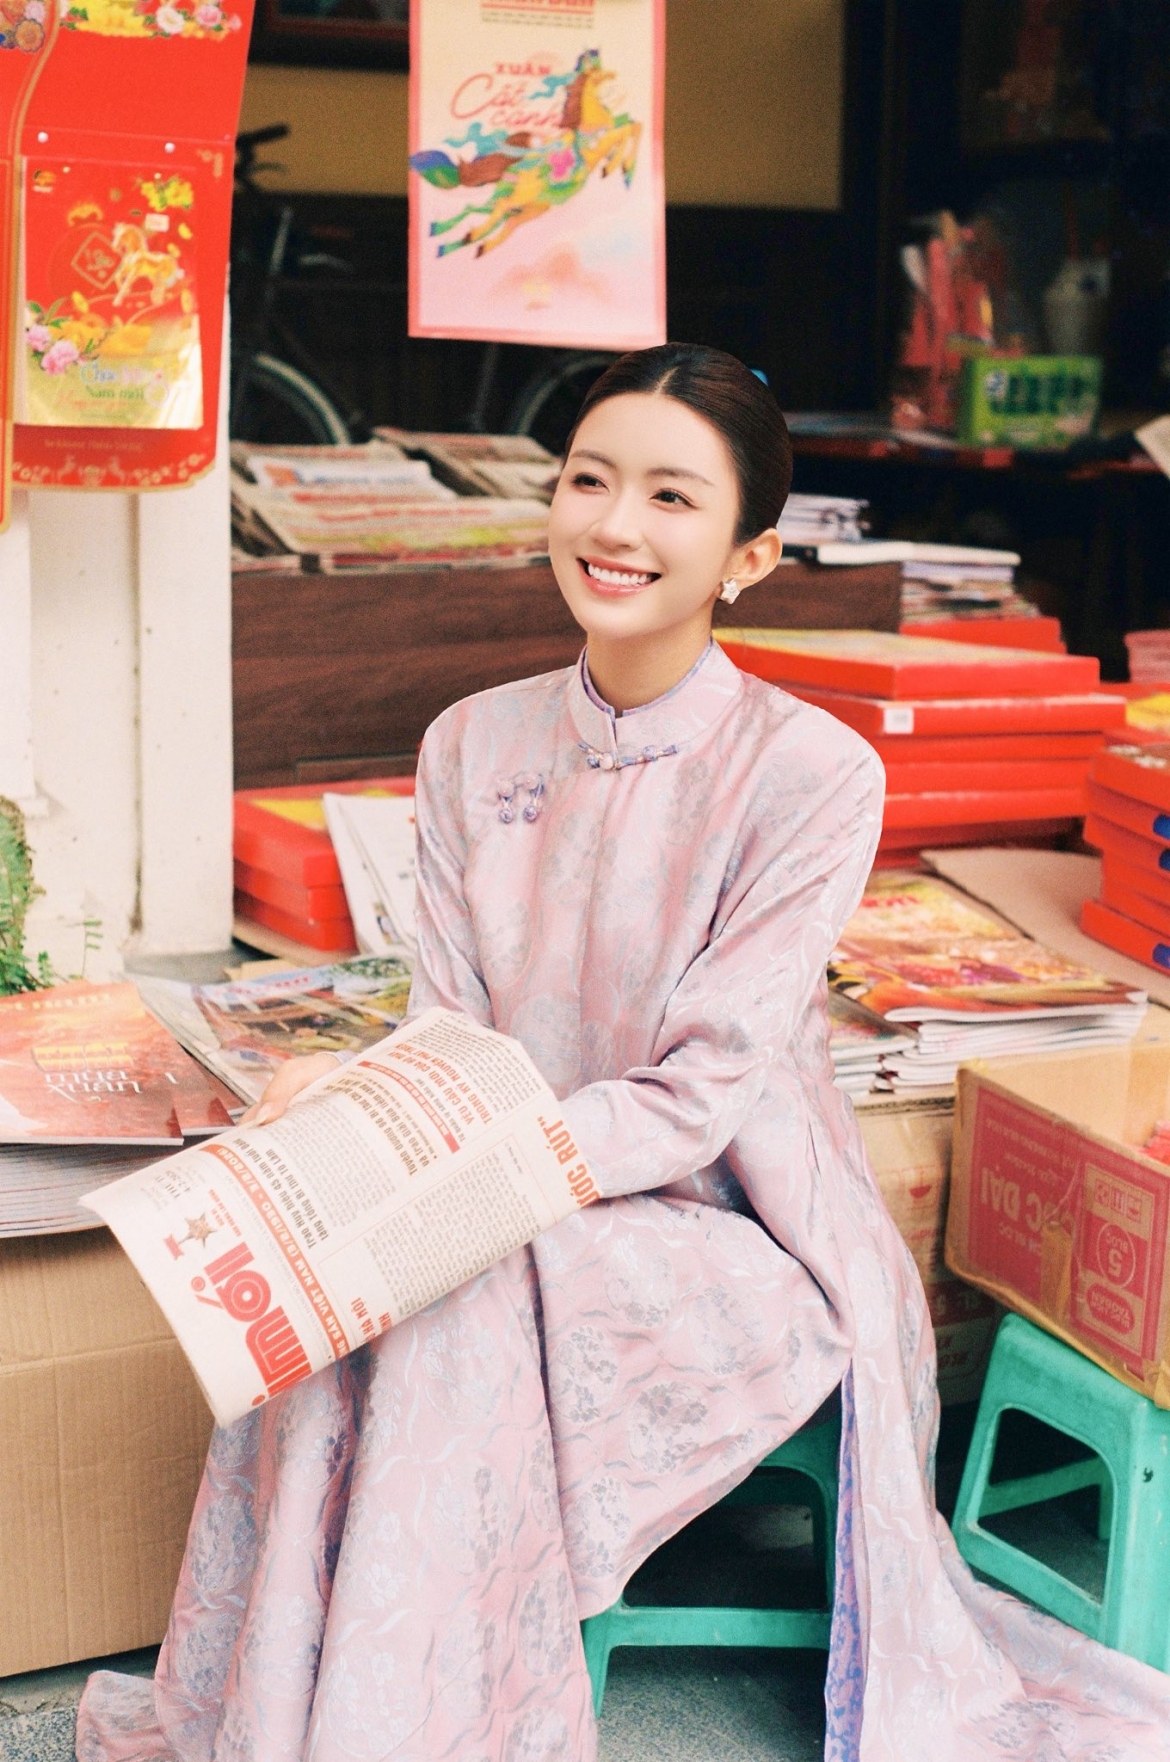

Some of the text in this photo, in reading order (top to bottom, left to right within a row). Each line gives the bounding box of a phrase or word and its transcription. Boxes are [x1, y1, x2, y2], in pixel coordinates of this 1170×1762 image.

[425, 1069, 447, 1088] MỚI
[429, 1056, 461, 1082] NGUYÊN
[440, 1086, 462, 1107] CẦU
[454, 1104, 475, 1126] YÊU
[466, 1092, 493, 1125] TRONG
[407, 1135, 424, 1156] trao
[256, 1160, 275, 1180] năm
[397, 1149, 419, 1176] Tuyên
[417, 1154, 431, 1167] và
[263, 1147, 330, 1241] tặng Tổng Bí thư Tô Lâm
[269, 1177, 283, 1192] 45
[289, 1208, 306, 1229] Huy
[299, 1226, 317, 1249] Trao
[293, 1257, 315, 1287] NAM
[1108, 1249, 1122, 1278] 5
[308, 1285, 331, 1316] VIỆT
[348, 1296, 369, 1320] NỘI
[323, 1314, 342, 1341] SẢN
[357, 1317, 375, 1336] HÀ
